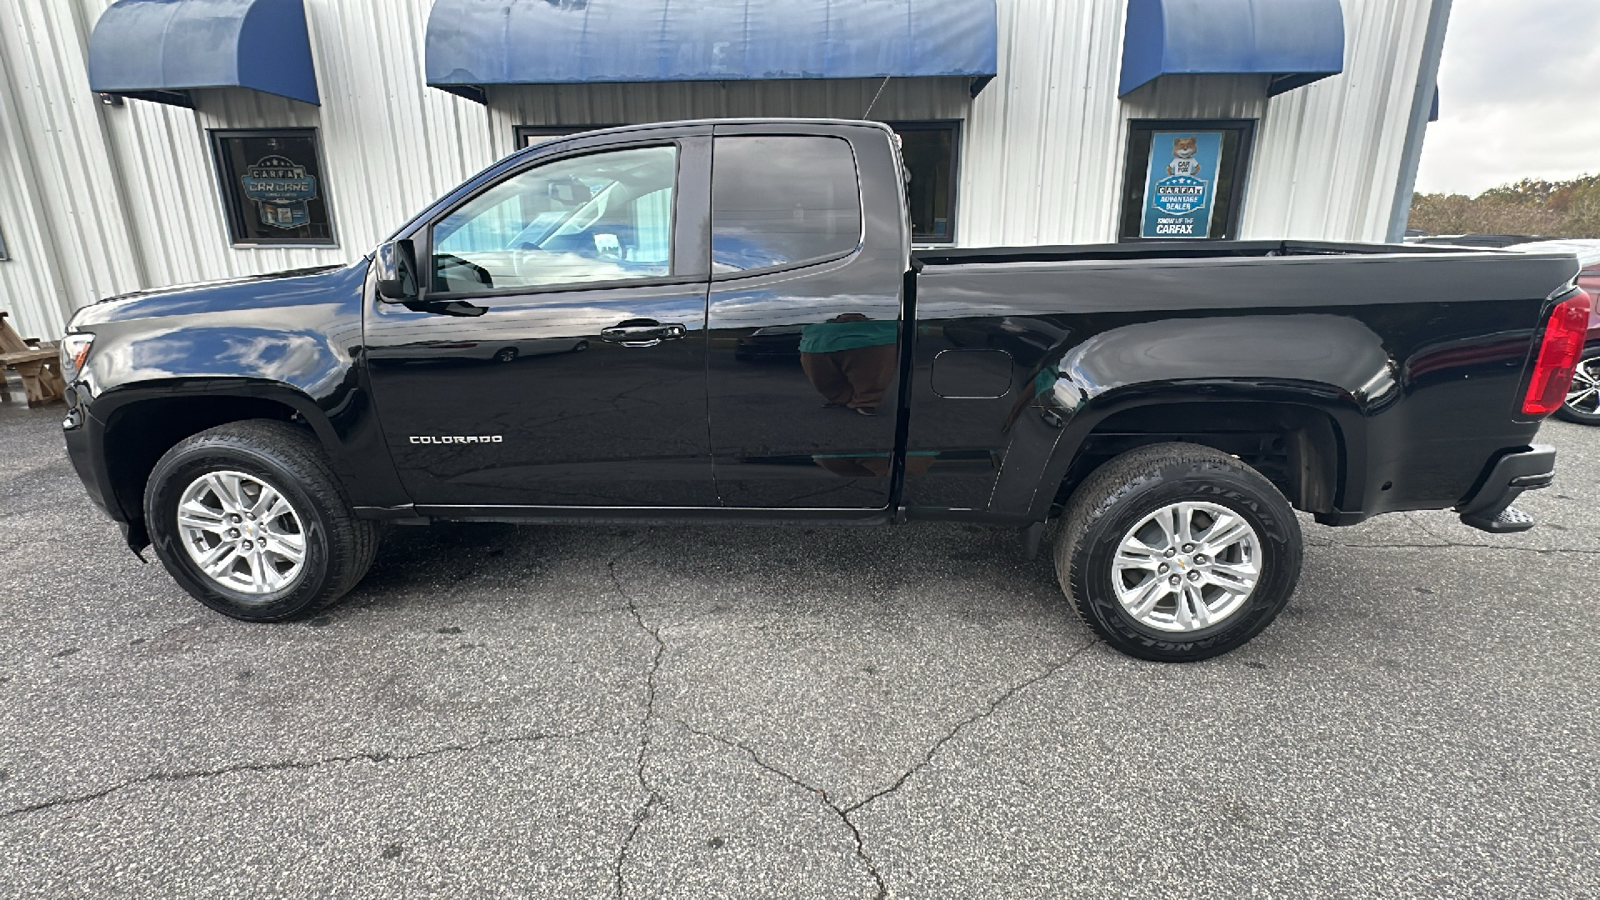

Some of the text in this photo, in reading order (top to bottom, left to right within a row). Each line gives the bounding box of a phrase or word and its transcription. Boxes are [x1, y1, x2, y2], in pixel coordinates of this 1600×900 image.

[253, 170, 304, 179] CARFAX
[249, 182, 309, 191] CAR CARE
[1156, 225, 1194, 234] CARFAX
[409, 435, 503, 444] COLORADO
